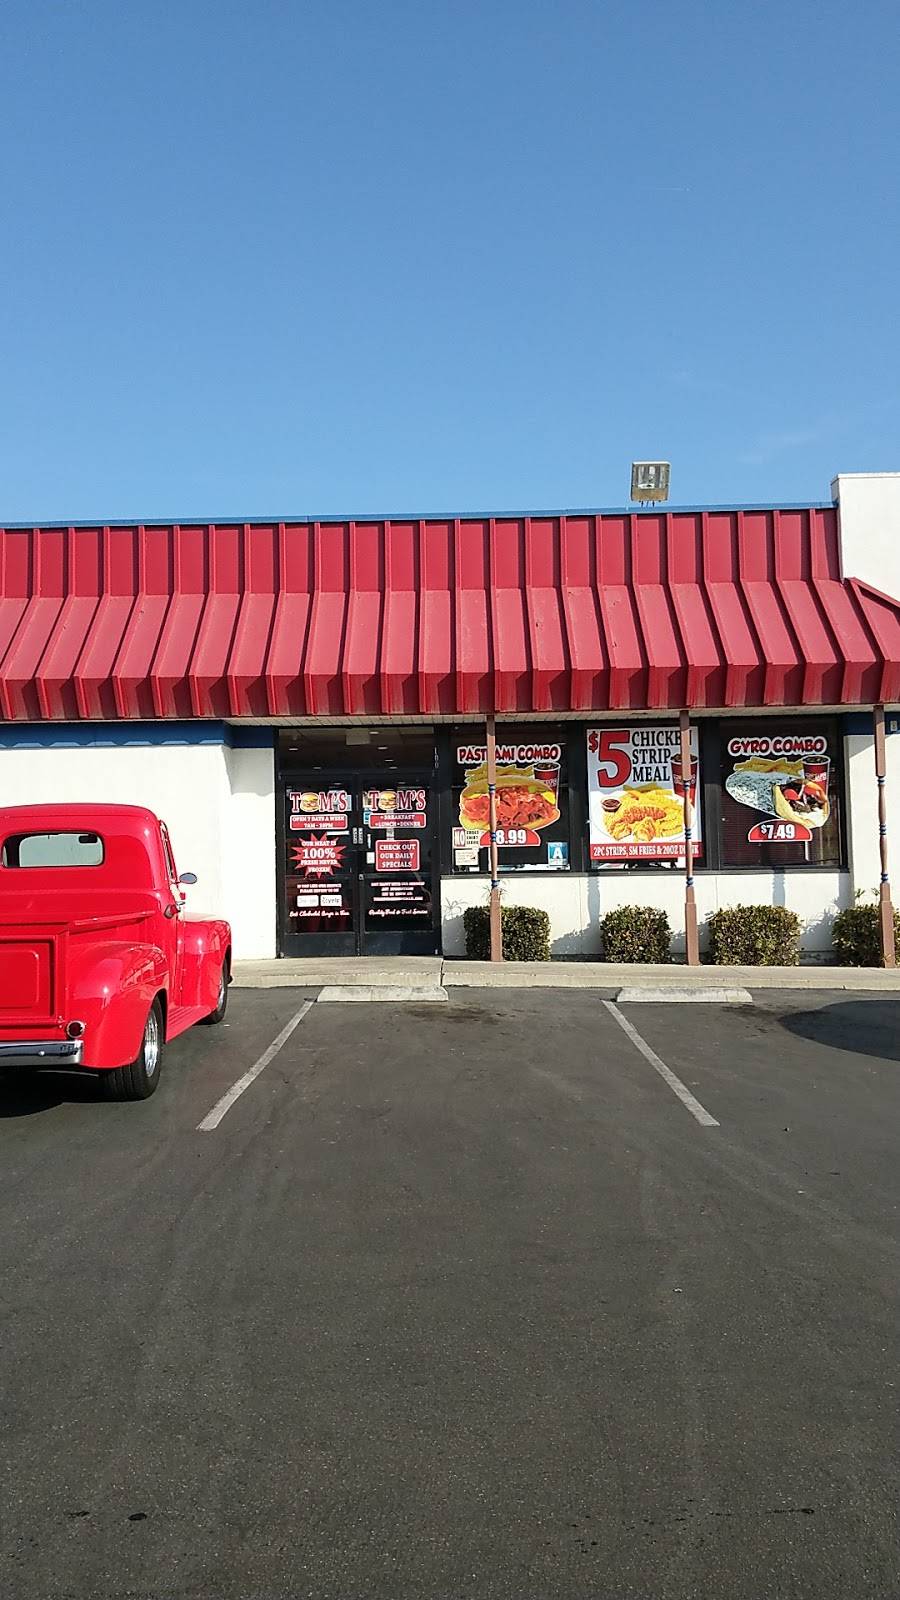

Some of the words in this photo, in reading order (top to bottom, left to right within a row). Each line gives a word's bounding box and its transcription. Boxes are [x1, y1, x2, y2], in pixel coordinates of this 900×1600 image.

[632, 730, 692, 746] CHICKE
[729, 738, 770, 755] GYRO
[772, 737, 826, 754] COMBO
[457, 746, 516, 763] PASTAMI
[517, 744, 560, 762] COMBO
[588, 730, 631, 787] $5
[632, 748, 671, 764] STRIP
[632, 766, 670, 782] MEAL
[761, 824, 795, 839] $7.49
[302, 848, 336, 859] 100%
[605, 846, 628, 857] STRIPS,
[639, 845, 656, 855] FRIES
